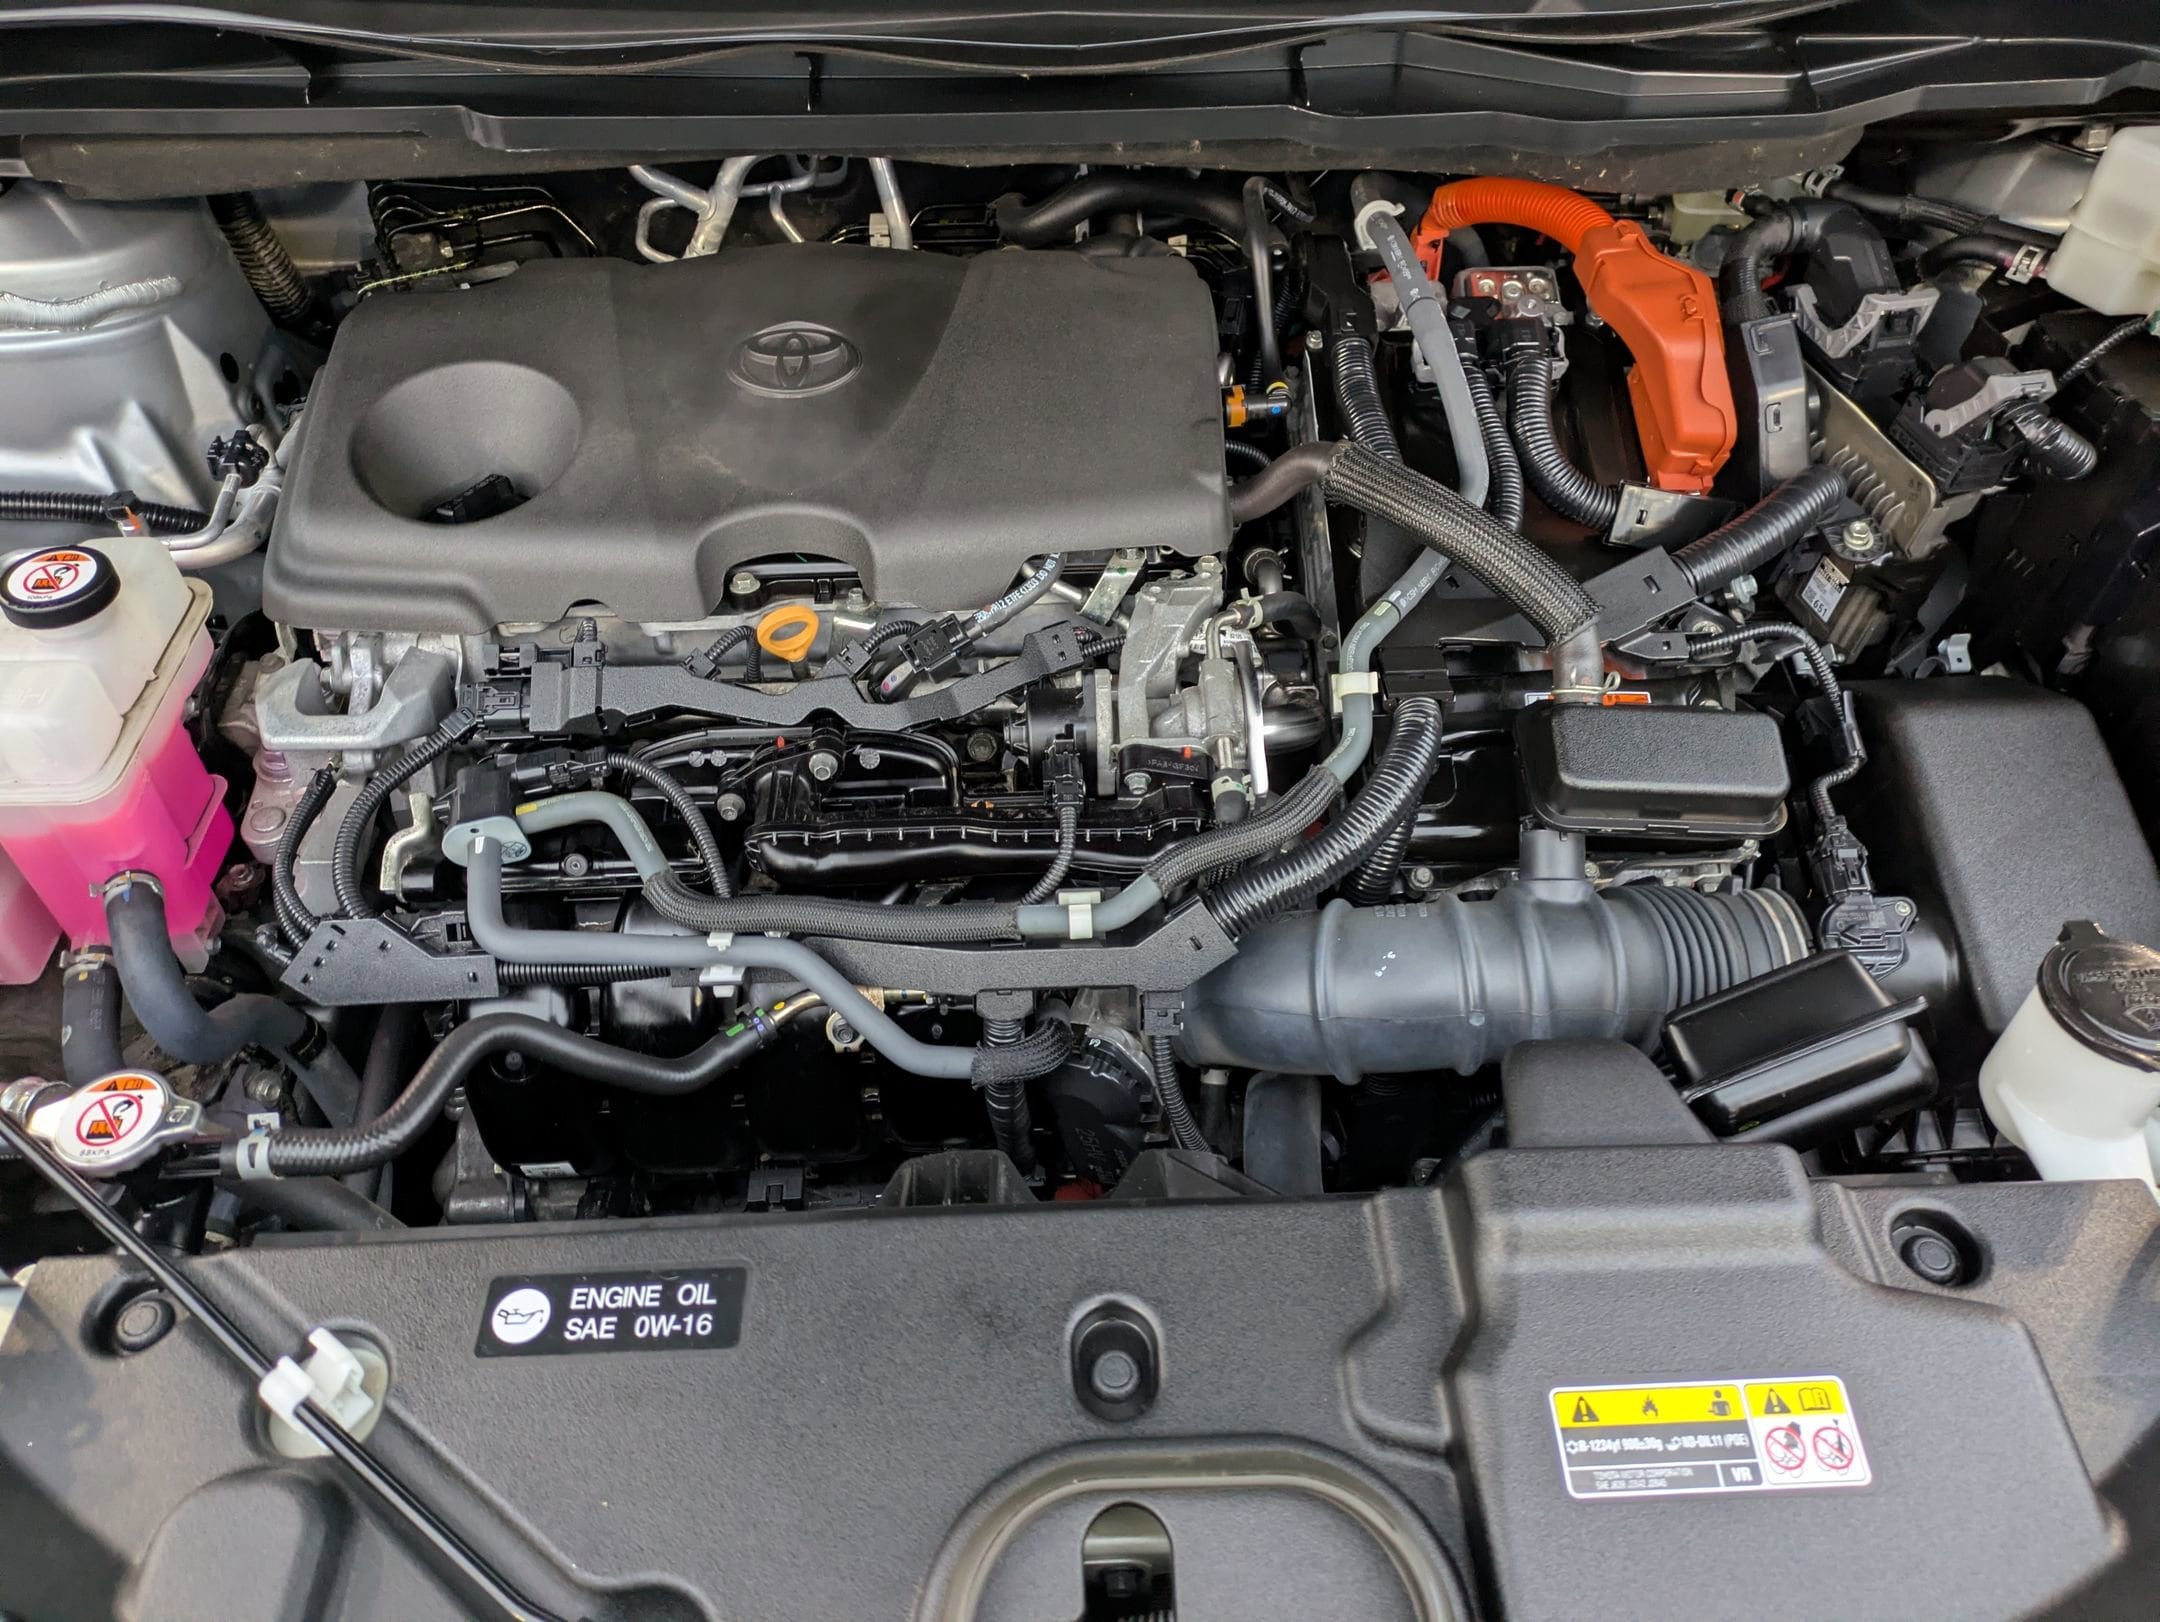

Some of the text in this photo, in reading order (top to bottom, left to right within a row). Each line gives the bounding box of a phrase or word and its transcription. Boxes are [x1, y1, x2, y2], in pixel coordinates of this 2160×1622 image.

[1813, 599, 1828, 617] 651
[569, 1282, 718, 1310] ENGINE OIL
[563, 1313, 713, 1341] SAE 0W-16
[1730, 1467, 1753, 1482] VR
